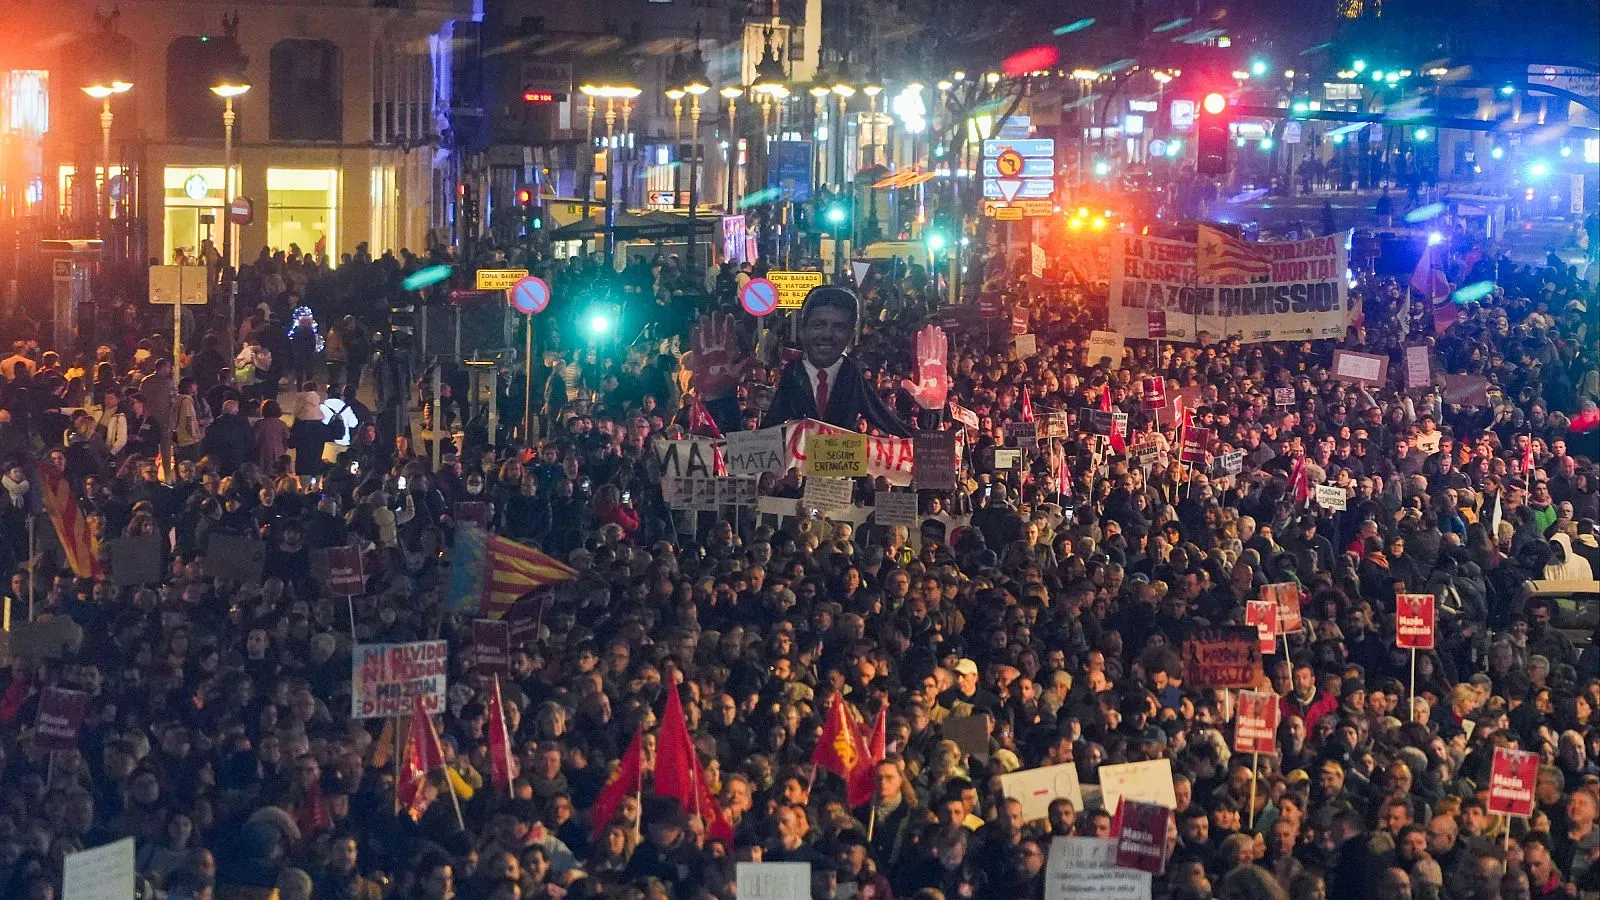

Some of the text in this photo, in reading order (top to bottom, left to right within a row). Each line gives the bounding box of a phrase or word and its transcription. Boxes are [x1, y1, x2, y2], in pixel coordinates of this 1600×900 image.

[731, 450, 782, 470] MATA
[814, 461, 861, 471] ENFANGATS
[1399, 615, 1424, 626] Mazón
[1399, 625, 1431, 635] dimissió
[1493, 773, 1523, 788] Mazón
[1492, 786, 1531, 801] dimissió
[1122, 827, 1153, 843] Mazón
[1120, 841, 1161, 856] dimissió
